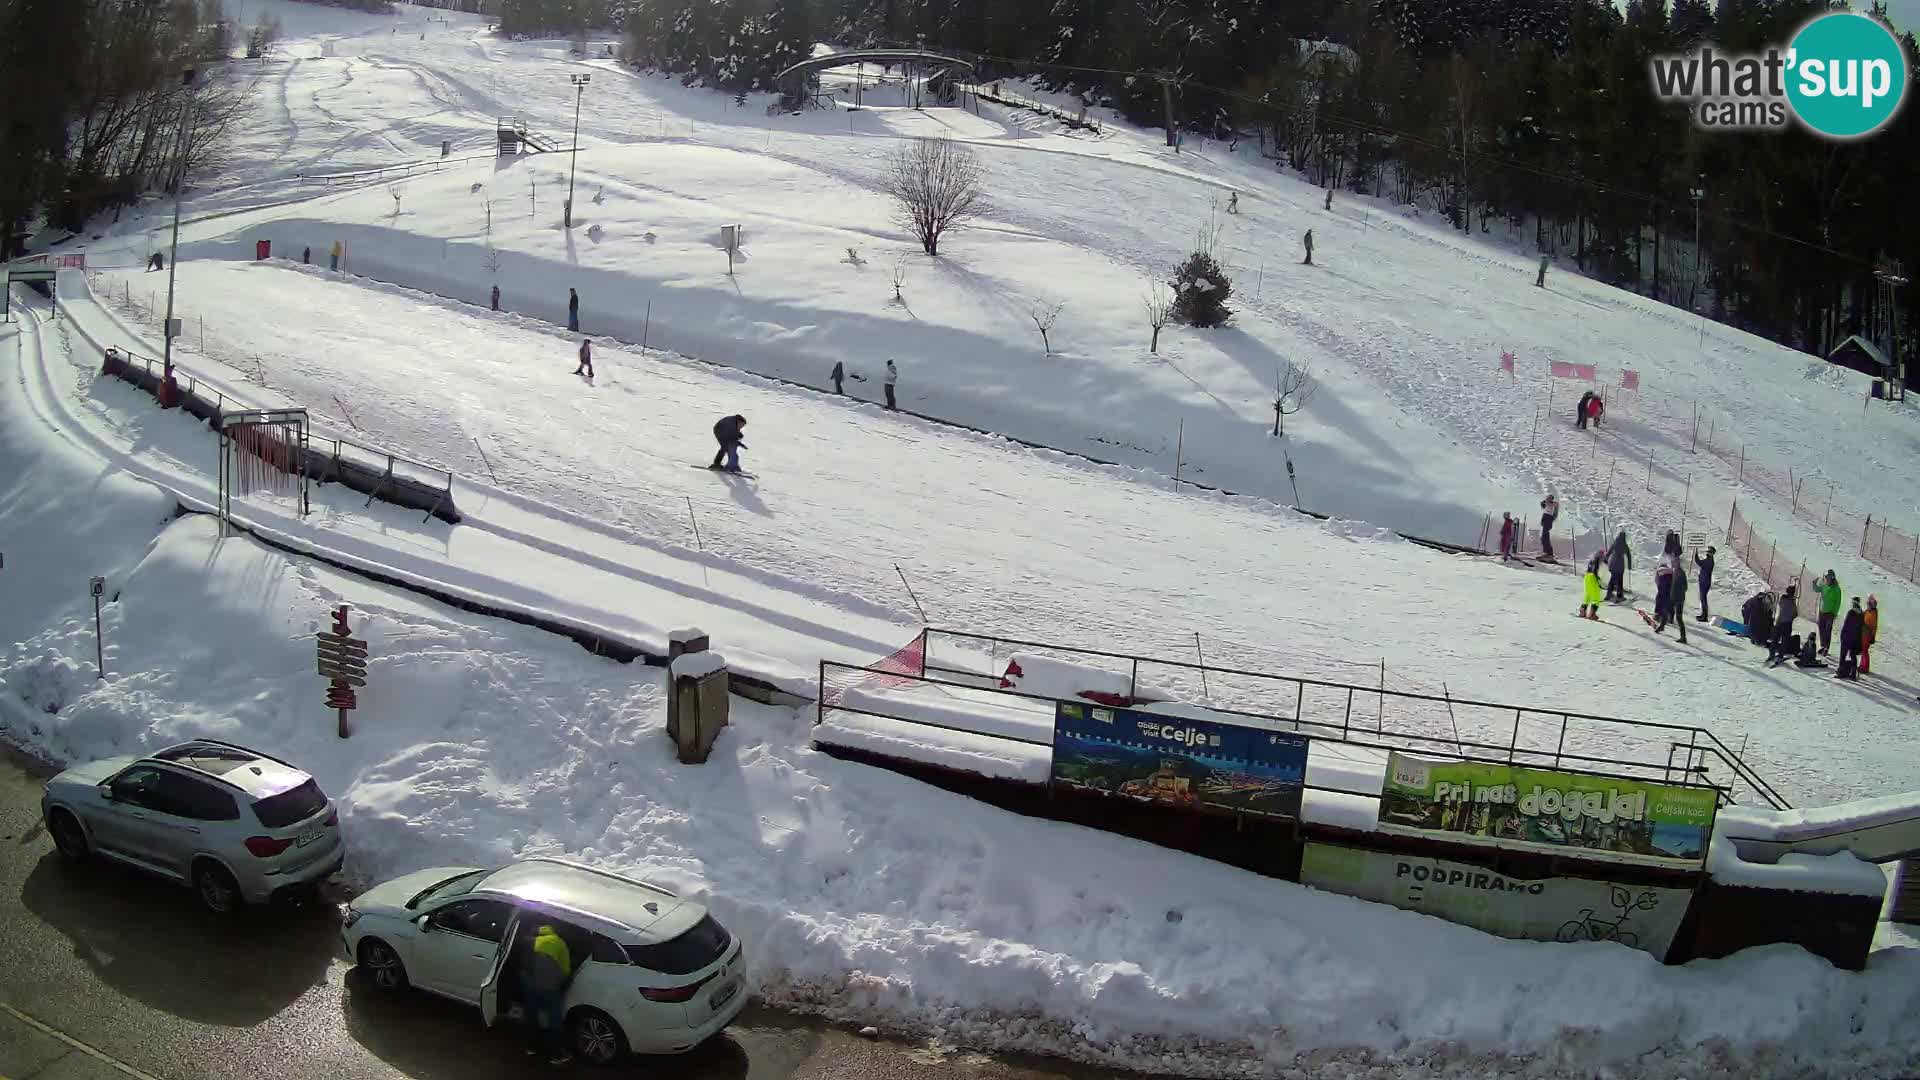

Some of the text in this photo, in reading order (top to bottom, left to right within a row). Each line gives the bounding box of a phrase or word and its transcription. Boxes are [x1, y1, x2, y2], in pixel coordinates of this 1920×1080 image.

[1161, 725, 1206, 746] Celje
[1433, 779, 1471, 803] Pri
[1475, 783, 1517, 804] nas
[1518, 785, 1647, 823] dogaja!
